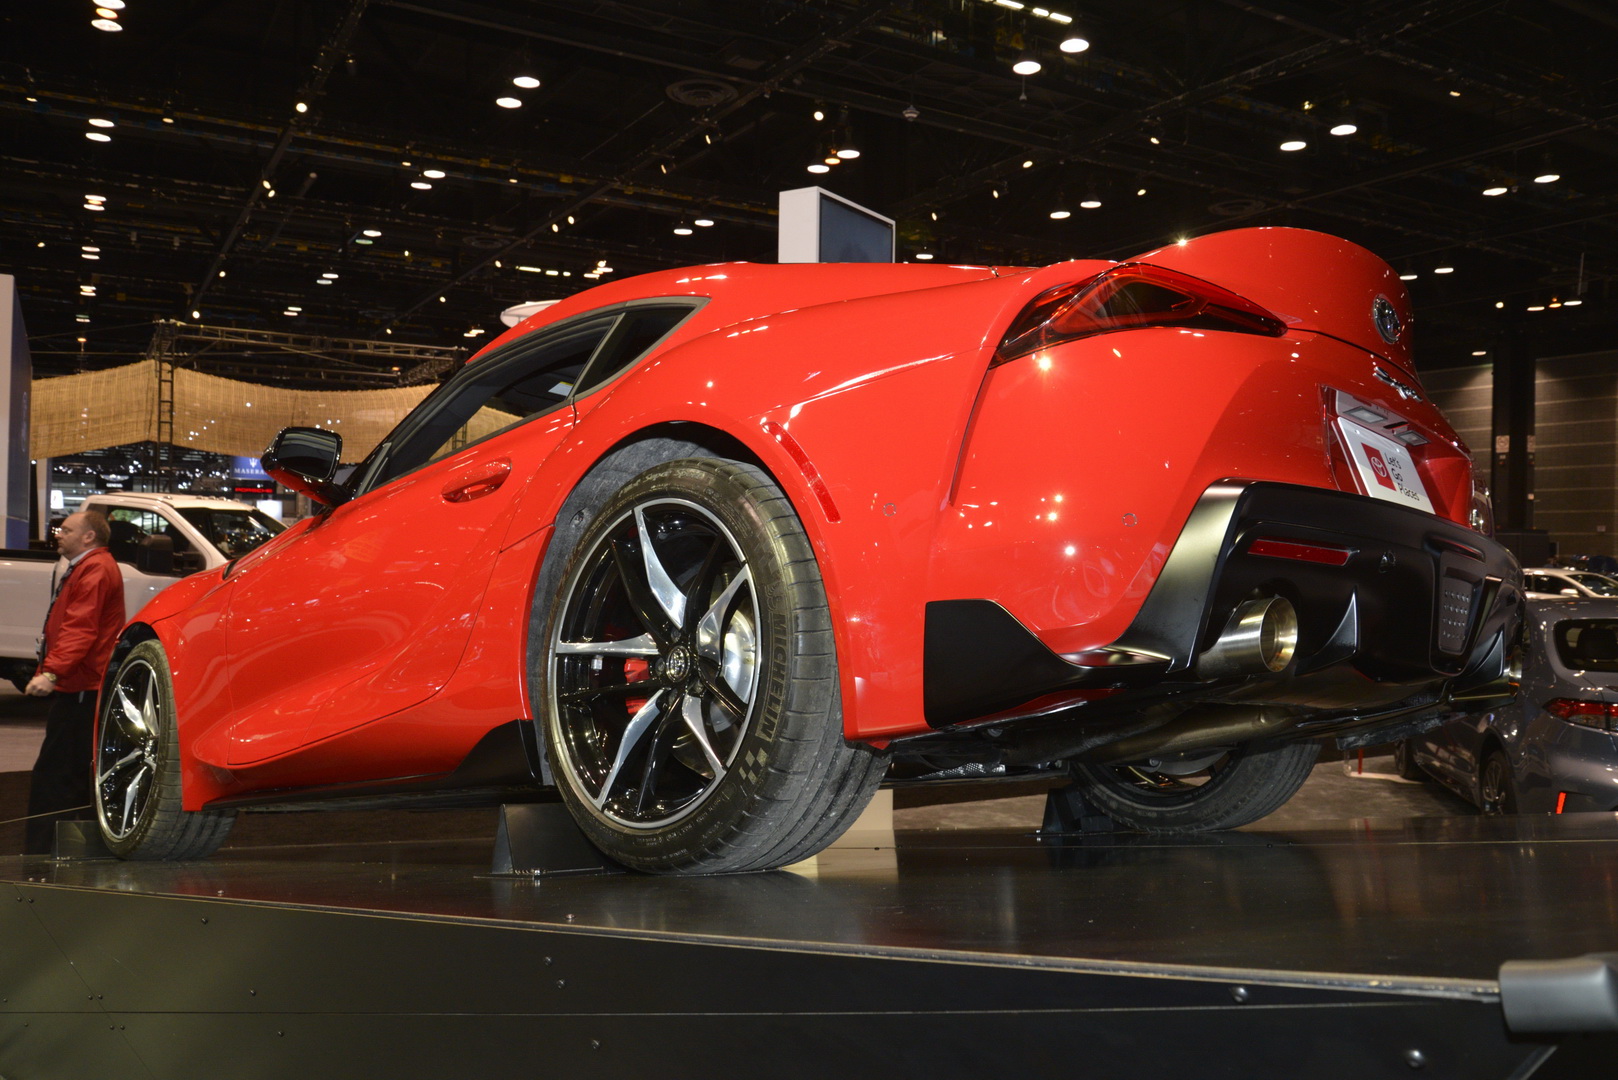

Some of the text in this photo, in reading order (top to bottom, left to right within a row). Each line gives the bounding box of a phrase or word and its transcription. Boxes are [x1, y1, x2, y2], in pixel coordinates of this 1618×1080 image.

[233, 467, 268, 475] MASERA
[1391, 467, 1404, 482] Go
[760, 613, 788, 739] MICHELIN
